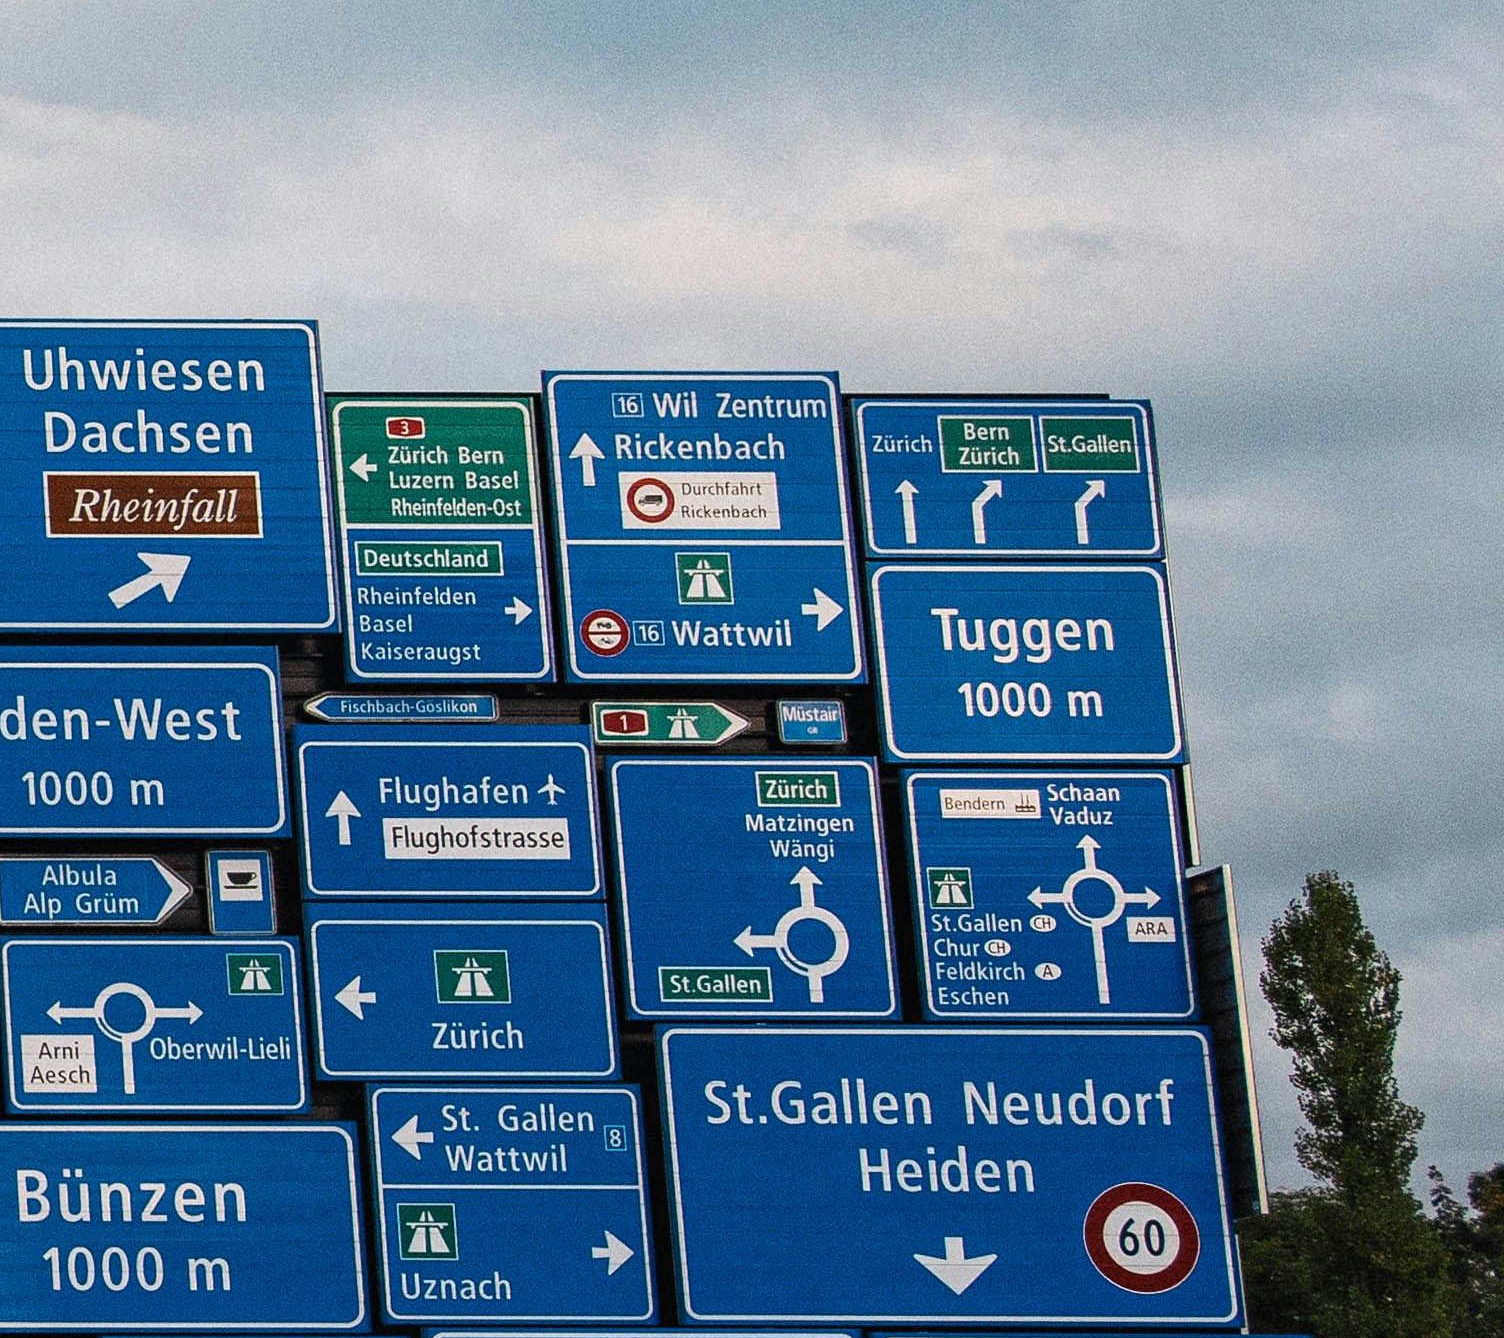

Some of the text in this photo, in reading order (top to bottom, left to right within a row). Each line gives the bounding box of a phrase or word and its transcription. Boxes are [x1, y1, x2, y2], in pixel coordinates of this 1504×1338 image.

[23, 346, 265, 392] Uhwiesen
[617, 391, 827, 419] 16 Wil Zentrum
[871, 434, 933, 453] Zürich
[1047, 434, 1132, 454] St.Gallen
[363, 548, 489, 568] Deutschland
[957, 681, 1103, 718] 1000 m
[392, 824, 565, 855] Flughofstrasse
[23, 891, 139, 920] Alp Grüm
[1134, 921, 1169, 936] ARA
[670, 973, 762, 994] St.Gallen
[149, 1036, 291, 1060] Oberwil-Lieli
[30, 1064, 91, 1085] Aesch
[704, 1077, 1174, 1126] St.Gallen Neudorf
[441, 1103, 595, 1132] St. Gallen
[1119, 1217, 1166, 1257] 60
[42, 1246, 231, 1292] 1000 m
